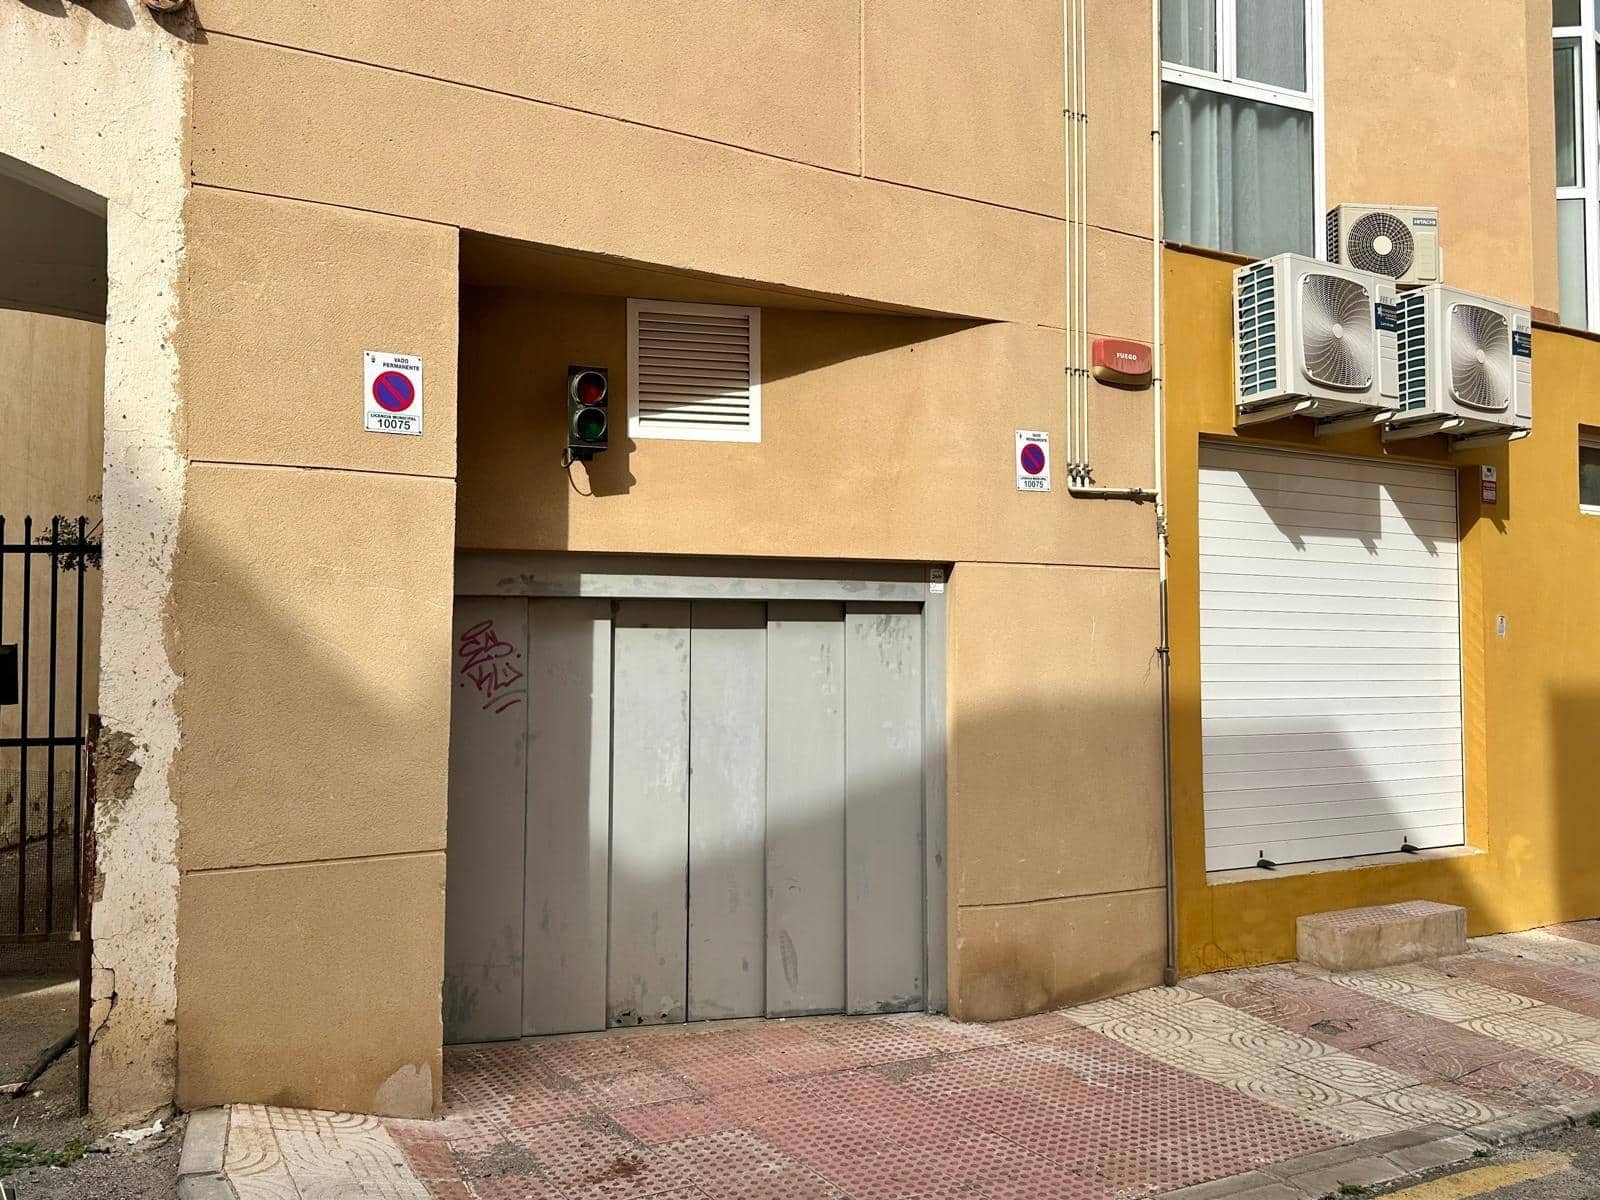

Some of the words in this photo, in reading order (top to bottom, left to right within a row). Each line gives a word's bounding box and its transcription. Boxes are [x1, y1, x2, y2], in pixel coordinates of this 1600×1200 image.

[1116, 352, 1137, 360] FUEGO
[382, 362, 420, 371] PERMANENTE
[377, 418, 411, 430] 10075
[1024, 480, 1044, 488] 10075
